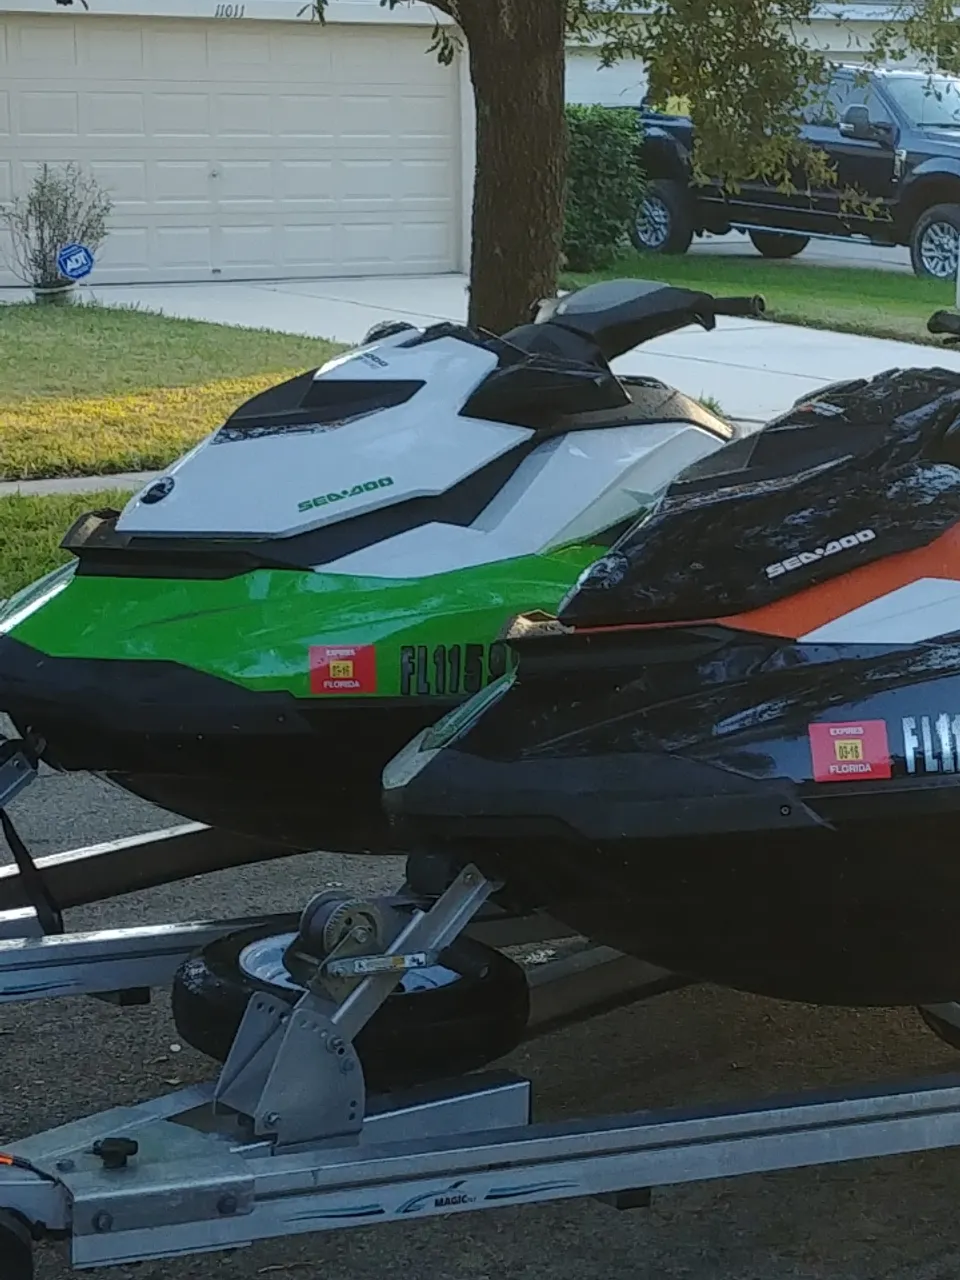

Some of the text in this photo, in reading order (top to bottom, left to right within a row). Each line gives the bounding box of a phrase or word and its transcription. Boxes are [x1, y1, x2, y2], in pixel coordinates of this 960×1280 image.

[215, 4, 245, 18] 11011
[66, 251, 88, 271] ADT
[401, 642, 519, 695] FL1159
[829, 763, 872, 774] FLORIDA
[435, 1194, 468, 1208] MAGIC
